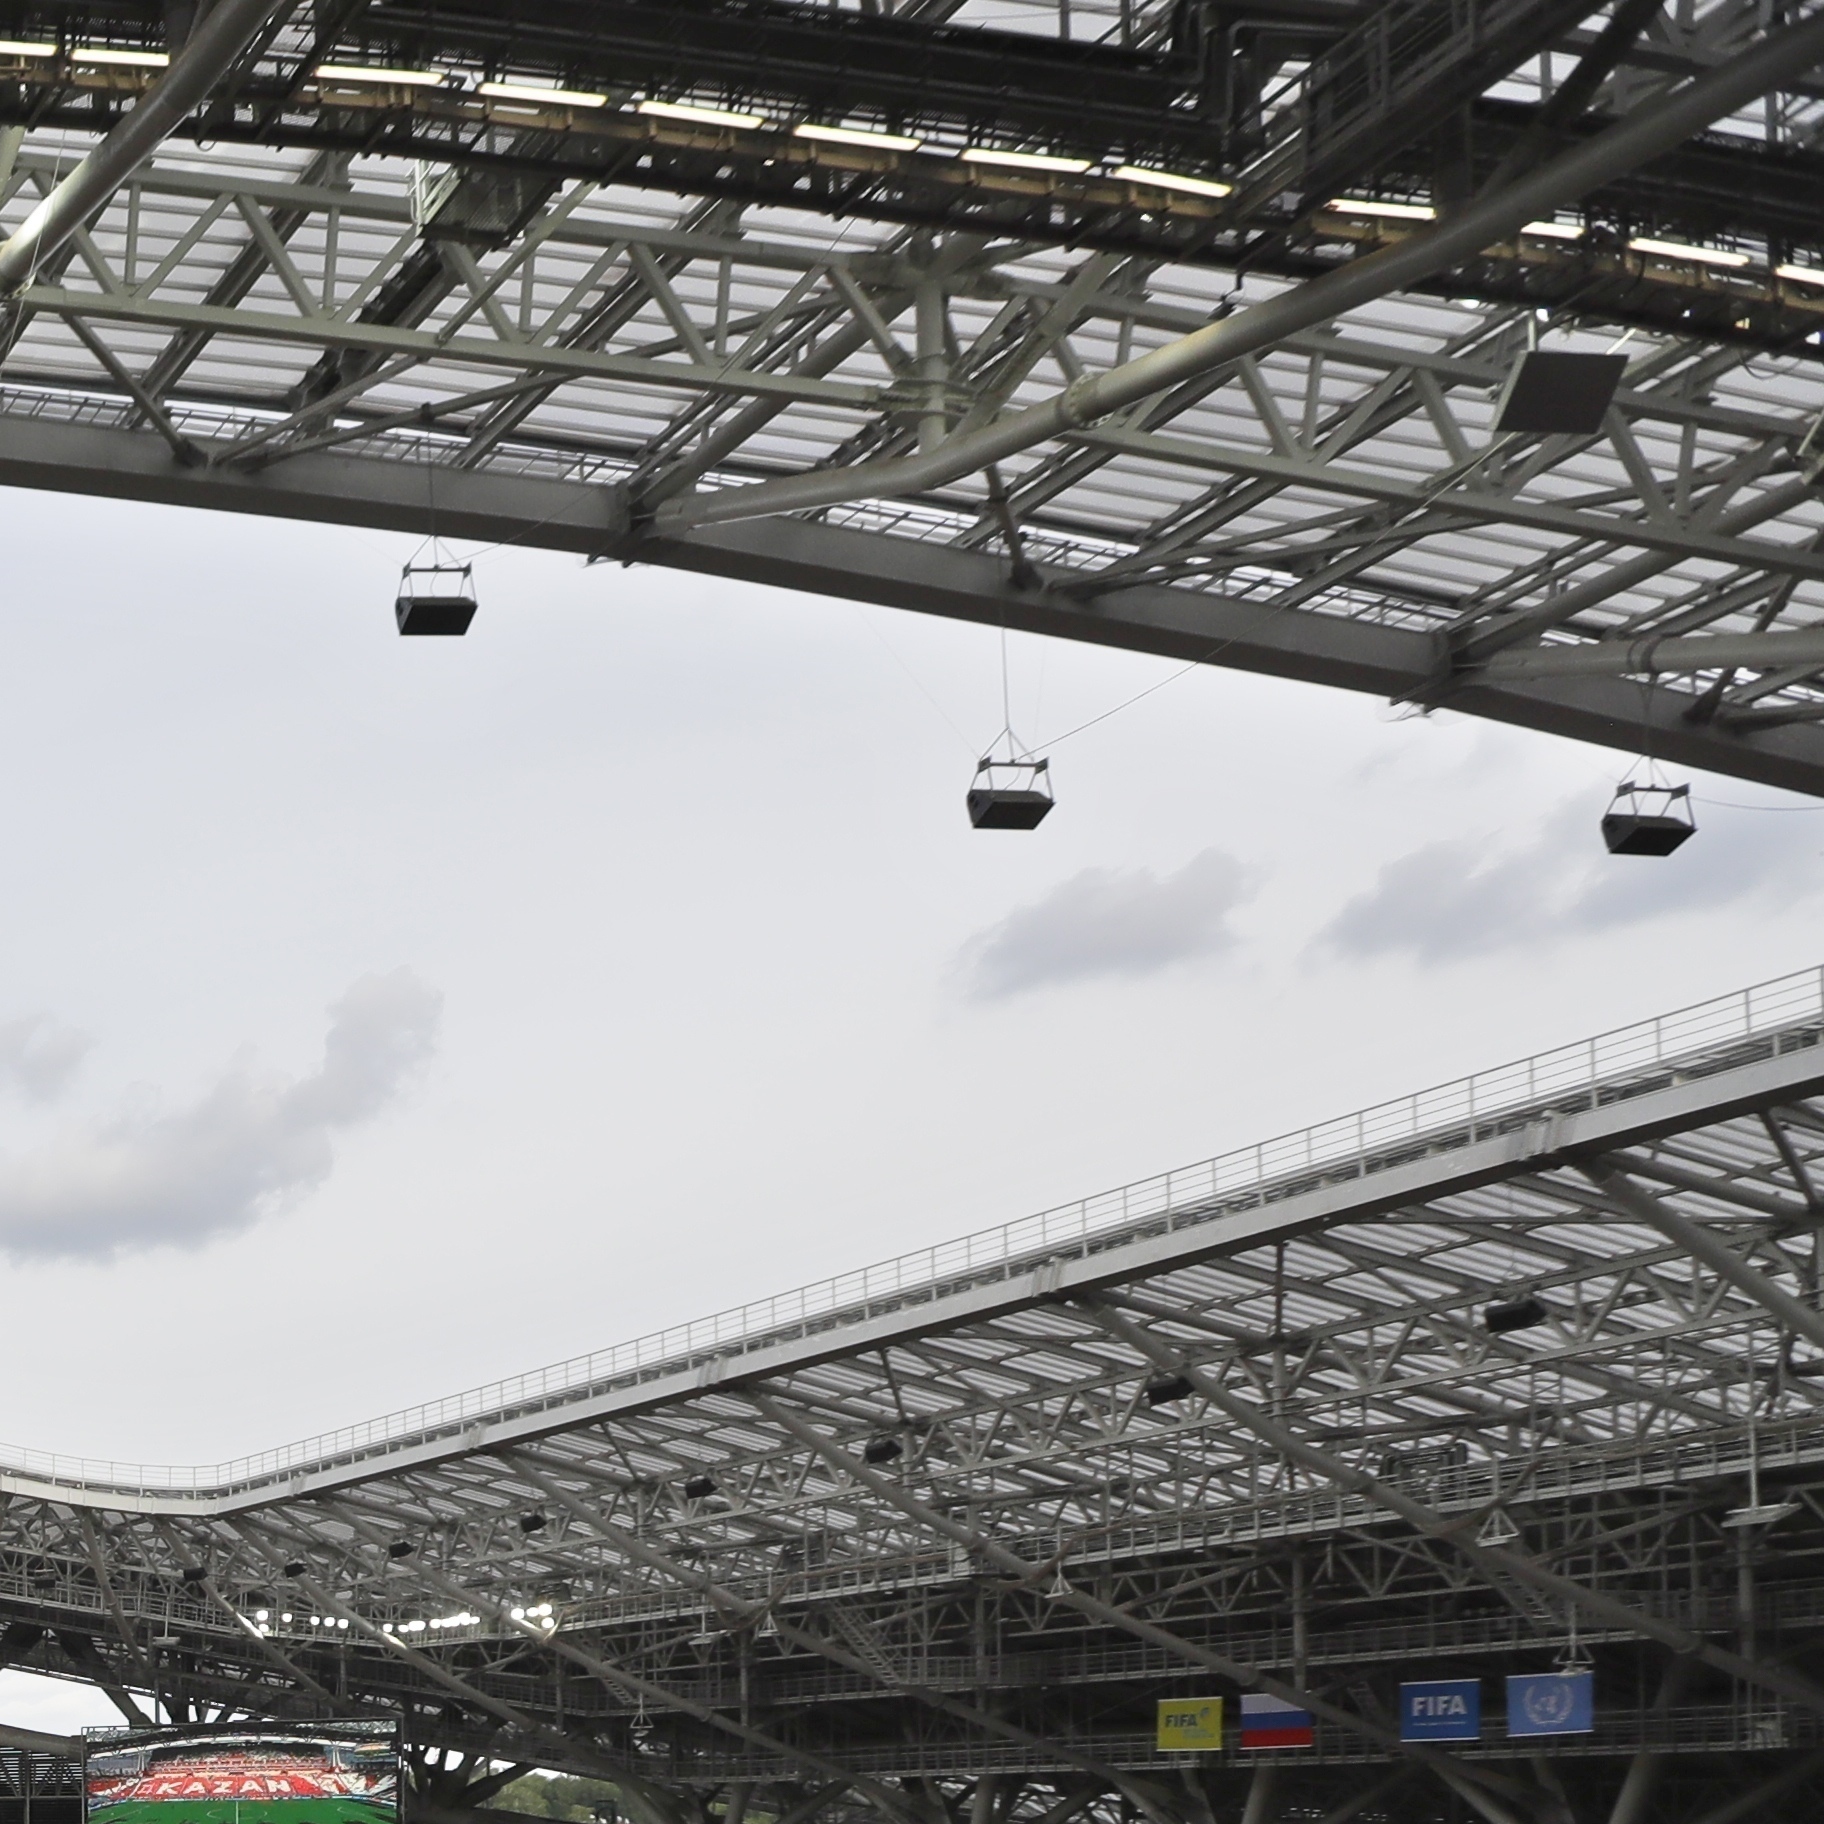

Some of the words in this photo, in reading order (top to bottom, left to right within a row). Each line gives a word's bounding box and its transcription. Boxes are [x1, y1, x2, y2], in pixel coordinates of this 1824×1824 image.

[1412, 1695, 1468, 1717] FIFA
[1165, 1714, 1198, 1728] FIFA
[155, 1778, 292, 1795] KAZAN
